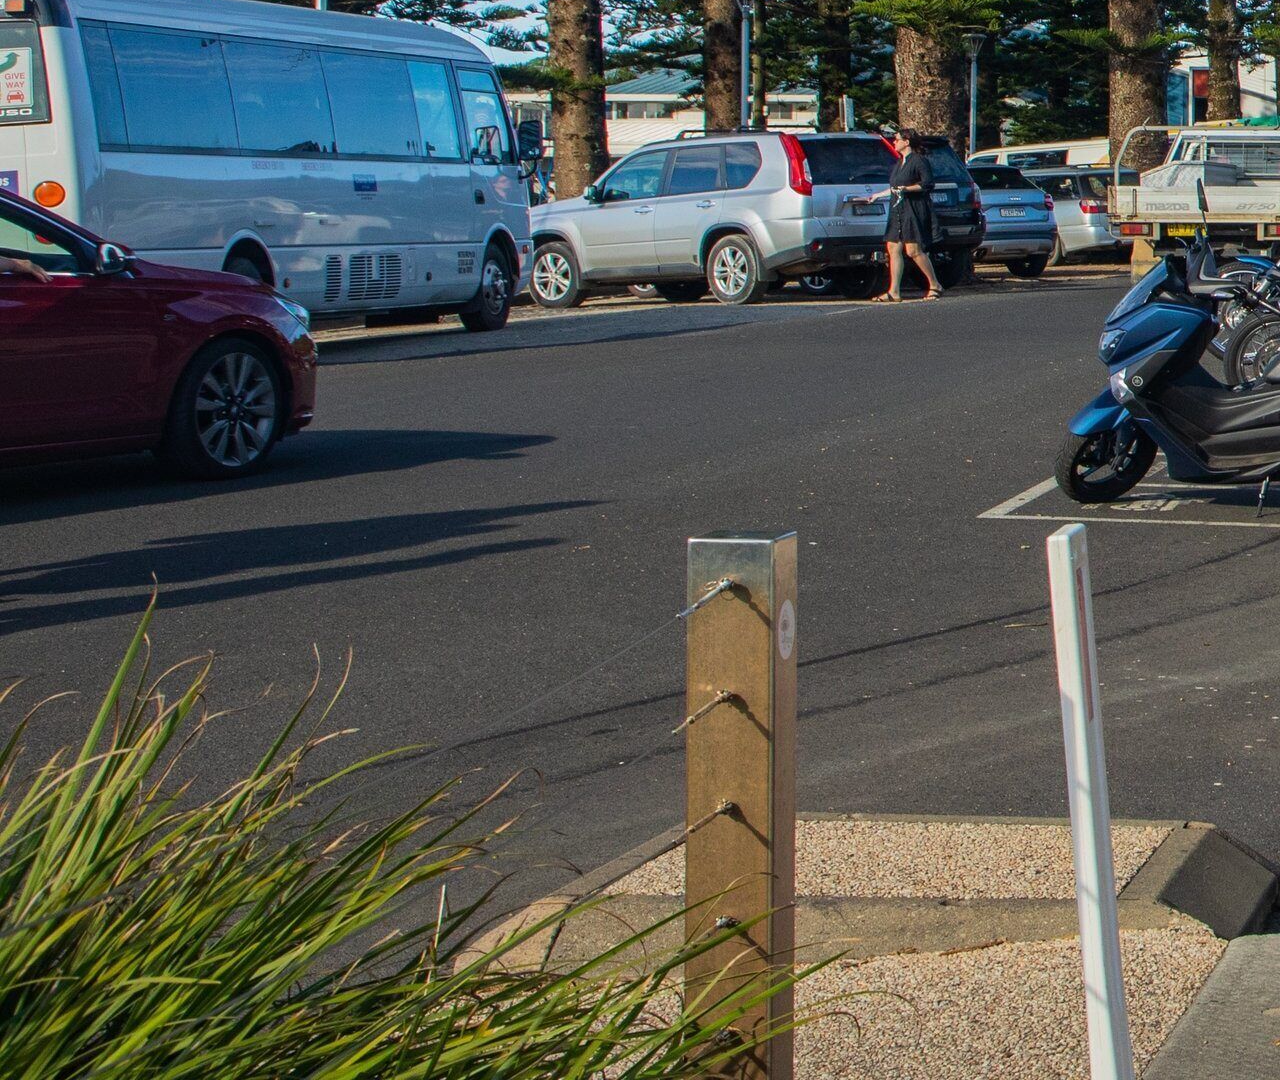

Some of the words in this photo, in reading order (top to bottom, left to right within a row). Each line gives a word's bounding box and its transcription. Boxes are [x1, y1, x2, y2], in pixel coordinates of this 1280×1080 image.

[4, 72, 26, 80] GIVE
[5, 81, 25, 89] WAY
[1145, 201, 1191, 212] mazda
[1236, 202, 1277, 211] BT-50
